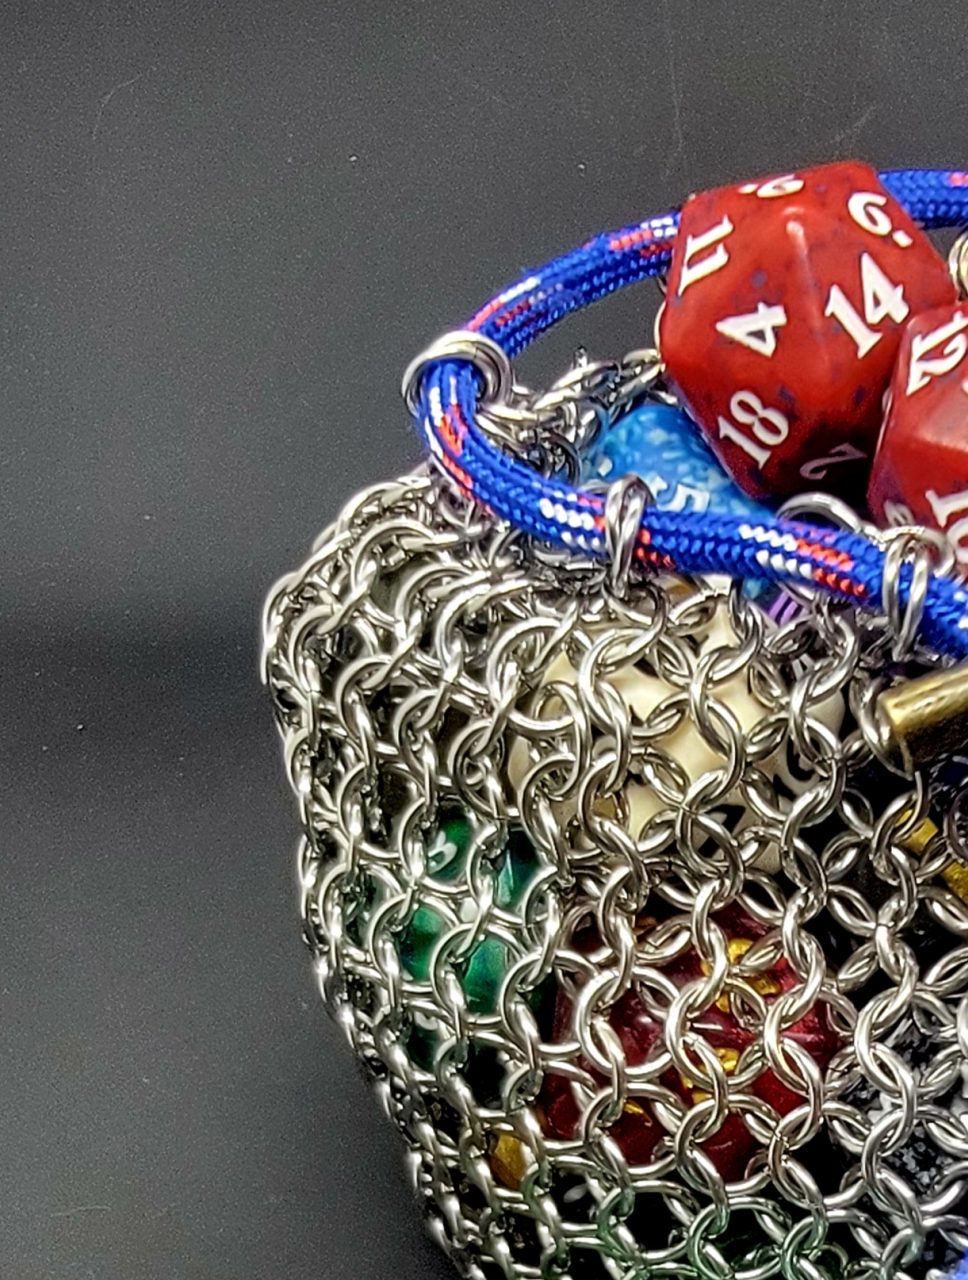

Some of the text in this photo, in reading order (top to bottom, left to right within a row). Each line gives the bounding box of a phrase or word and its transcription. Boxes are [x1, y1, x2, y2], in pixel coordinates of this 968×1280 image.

[716, 302, 787, 356] 4
[825, 253, 909, 358] 14
[718, 390, 789, 468] 18
